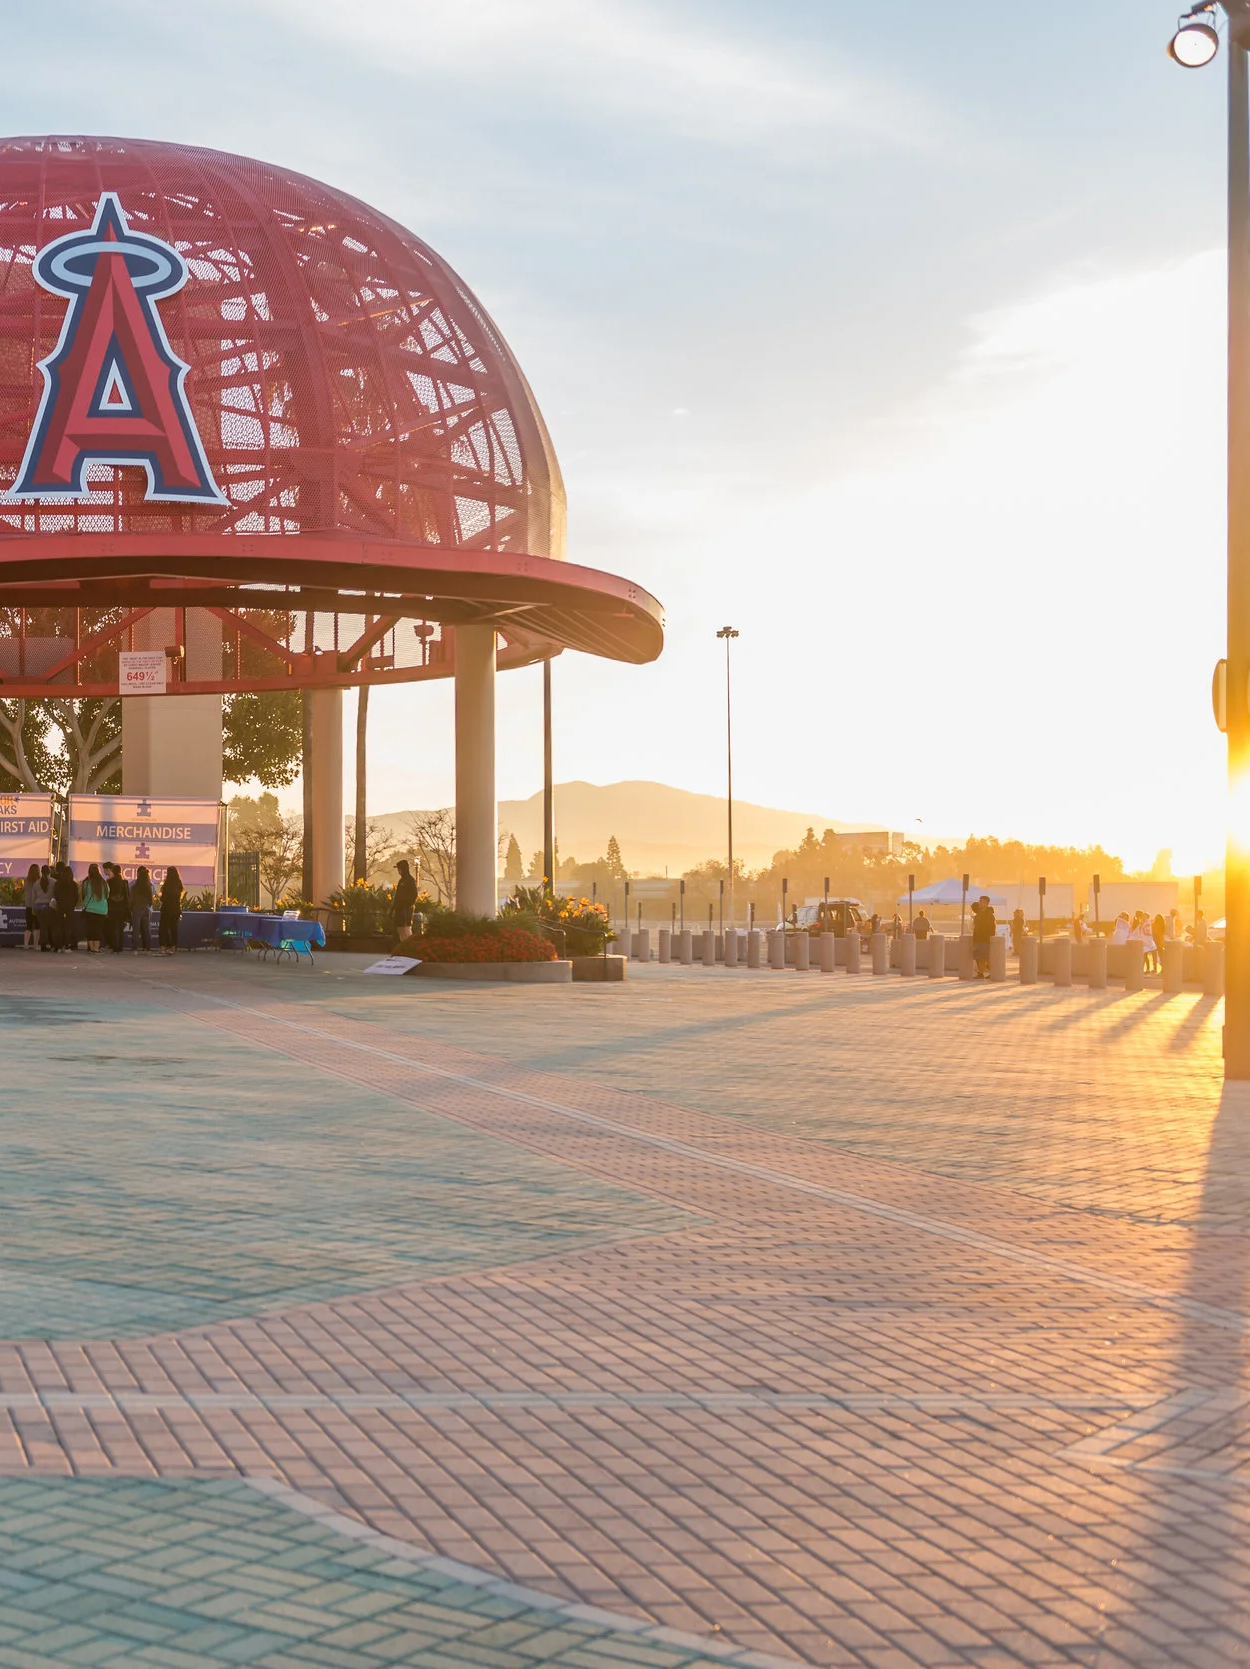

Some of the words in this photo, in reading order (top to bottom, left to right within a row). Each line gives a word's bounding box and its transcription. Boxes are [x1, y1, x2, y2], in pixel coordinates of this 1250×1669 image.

[5, 192, 232, 506] A
[28, 820, 49, 833] AID
[96, 825, 191, 840] MERCHANDISE
